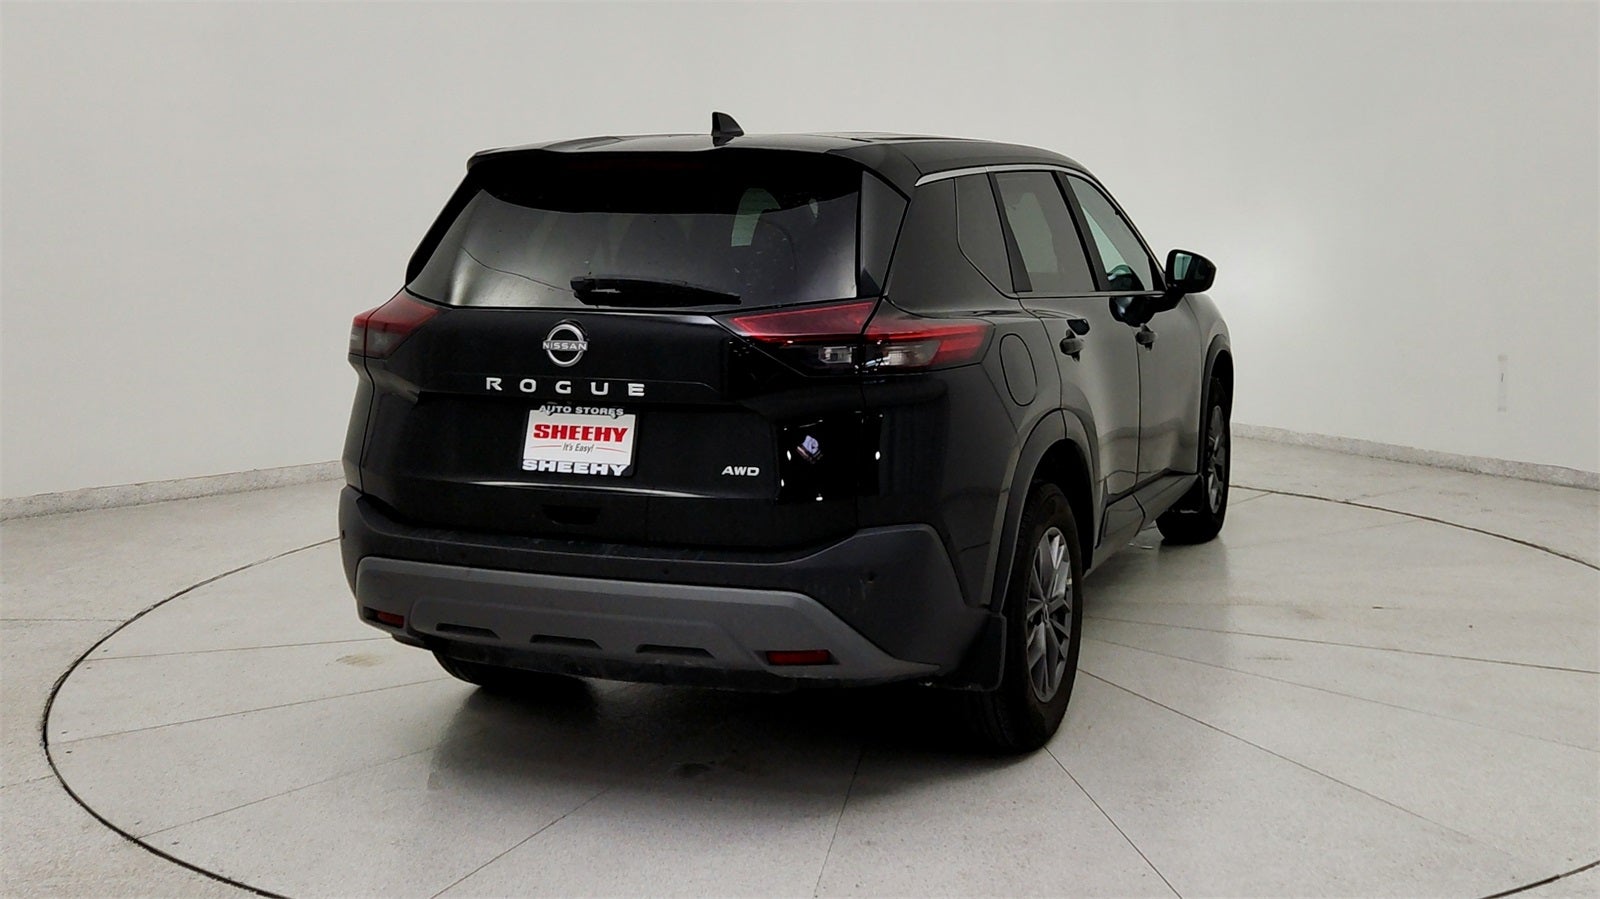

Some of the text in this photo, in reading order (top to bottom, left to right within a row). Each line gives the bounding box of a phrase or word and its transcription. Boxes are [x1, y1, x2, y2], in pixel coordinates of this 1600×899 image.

[542, 341, 588, 350] NISSAN
[485, 376, 645, 397] ROGUE
[539, 405, 624, 416] AUTO STORES
[533, 424, 628, 442] SHEEHY
[563, 443, 594, 453] It's Easy!
[522, 459, 629, 477] SHEEHY
[721, 465, 760, 476] AWD
